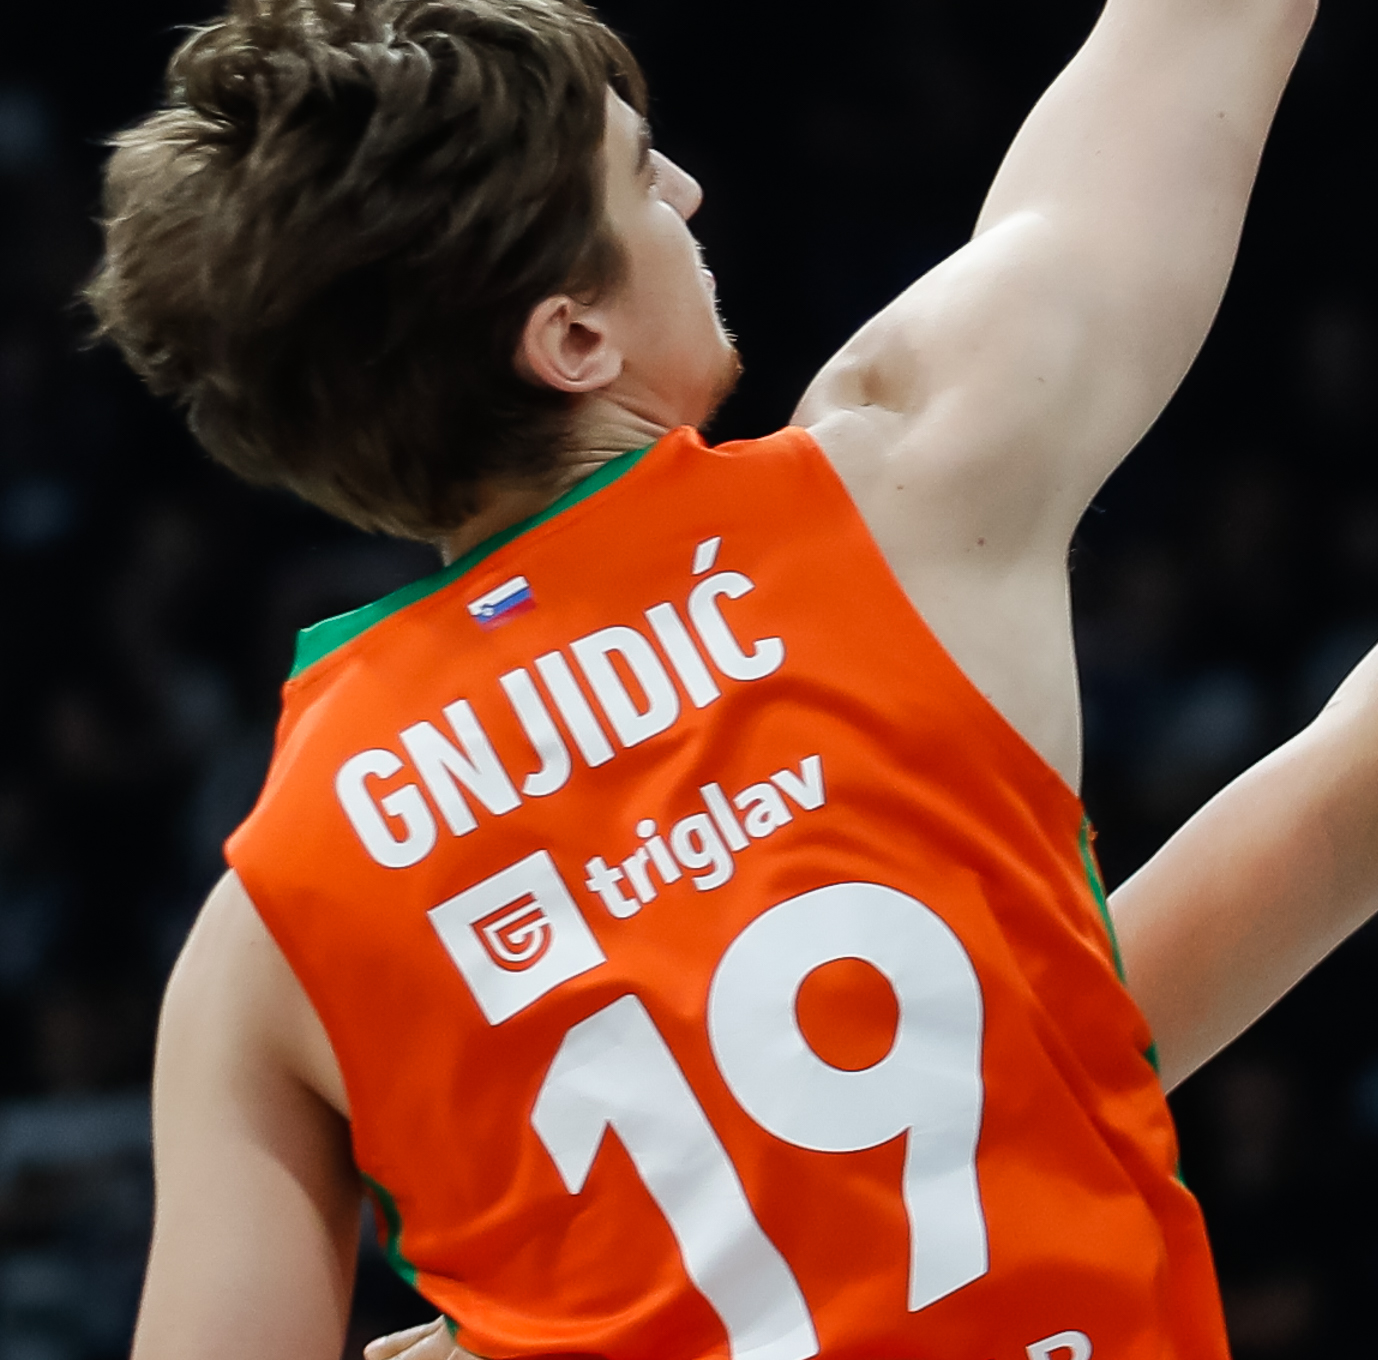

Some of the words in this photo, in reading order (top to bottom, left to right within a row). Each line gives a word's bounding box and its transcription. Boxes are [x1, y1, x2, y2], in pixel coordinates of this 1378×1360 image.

[333, 536, 785, 869] GNJIDIĆ
[584, 754, 827, 919] triglav
[530, 881, 989, 1360] 19
